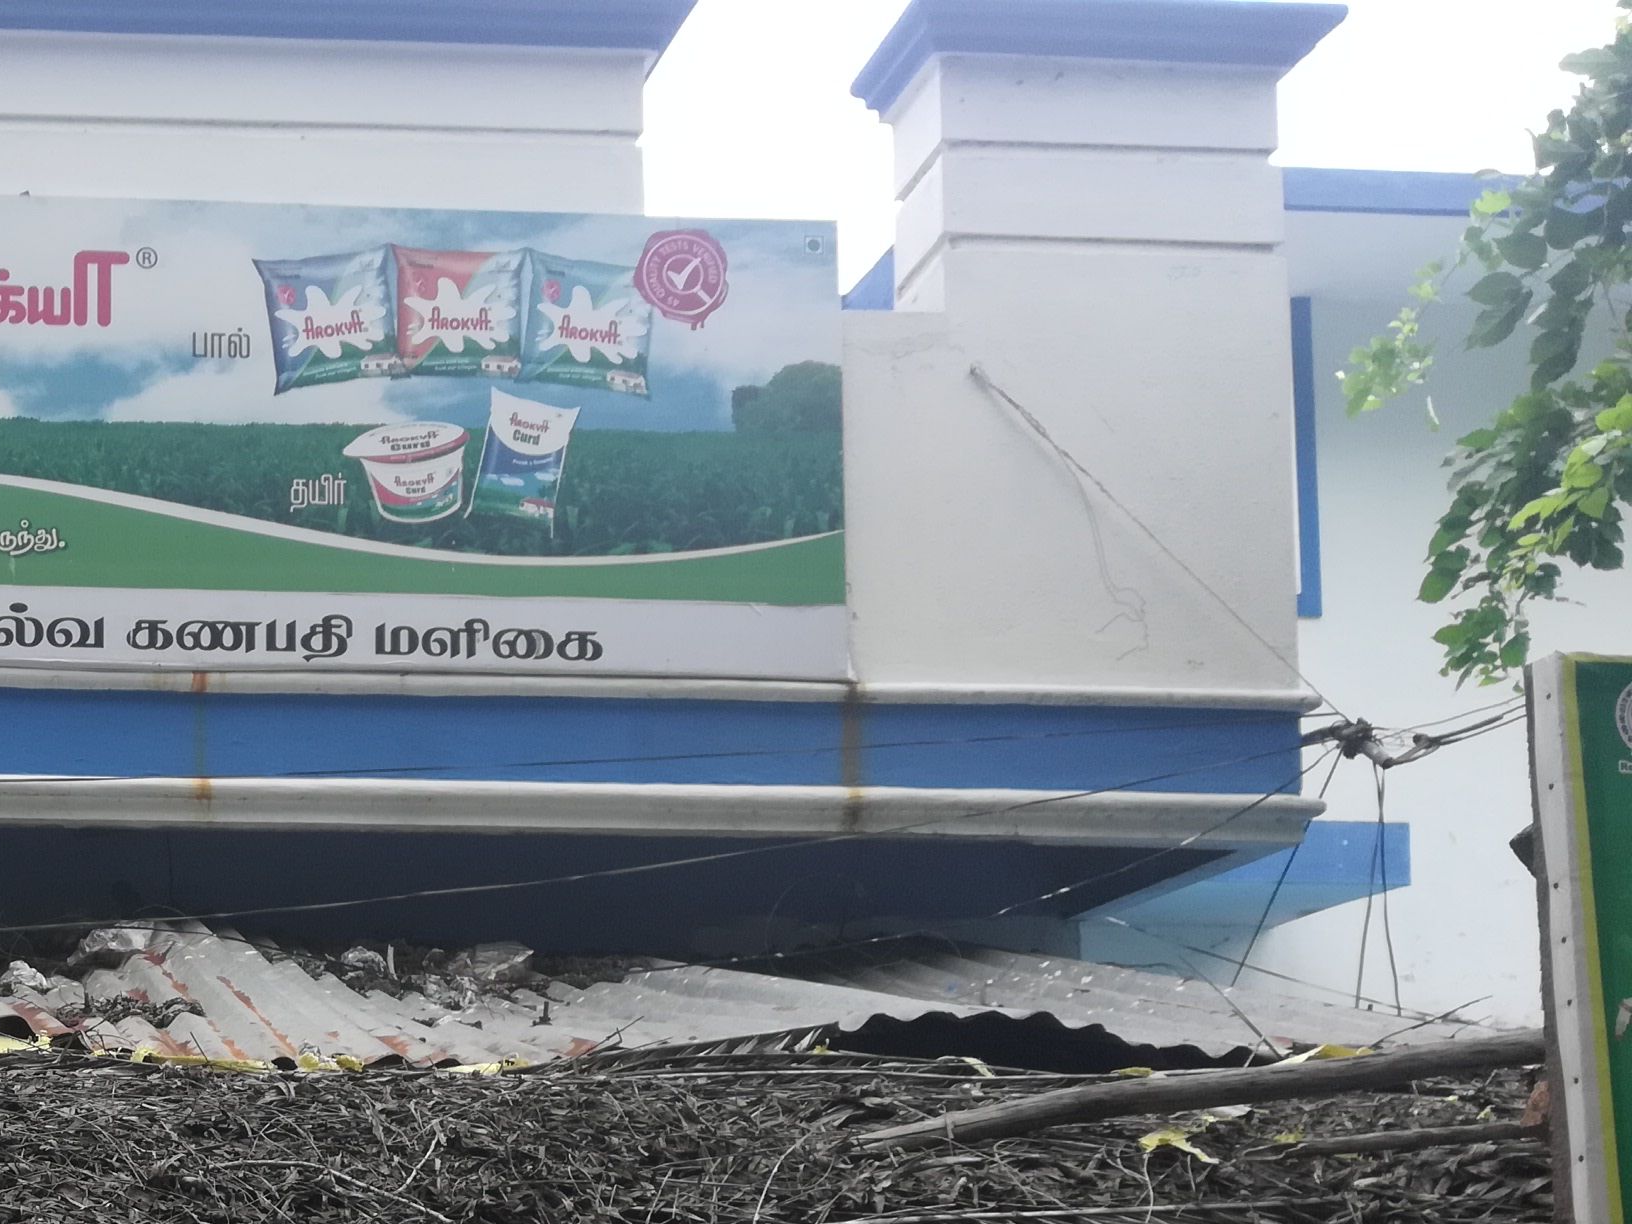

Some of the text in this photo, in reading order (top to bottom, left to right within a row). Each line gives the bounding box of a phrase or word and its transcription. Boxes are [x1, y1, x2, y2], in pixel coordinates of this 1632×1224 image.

[302, 309, 365, 340] AROKYA
[428, 305, 492, 331] AROKYA
[558, 314, 621, 345] AROKYA
[191, 325, 252, 360] பால்
[511, 428, 542, 447] Curd
[289, 471, 347, 513] தயிர்
[127, 612, 354, 664] கணபதி
[373, 619, 605, 663] மளிகை
